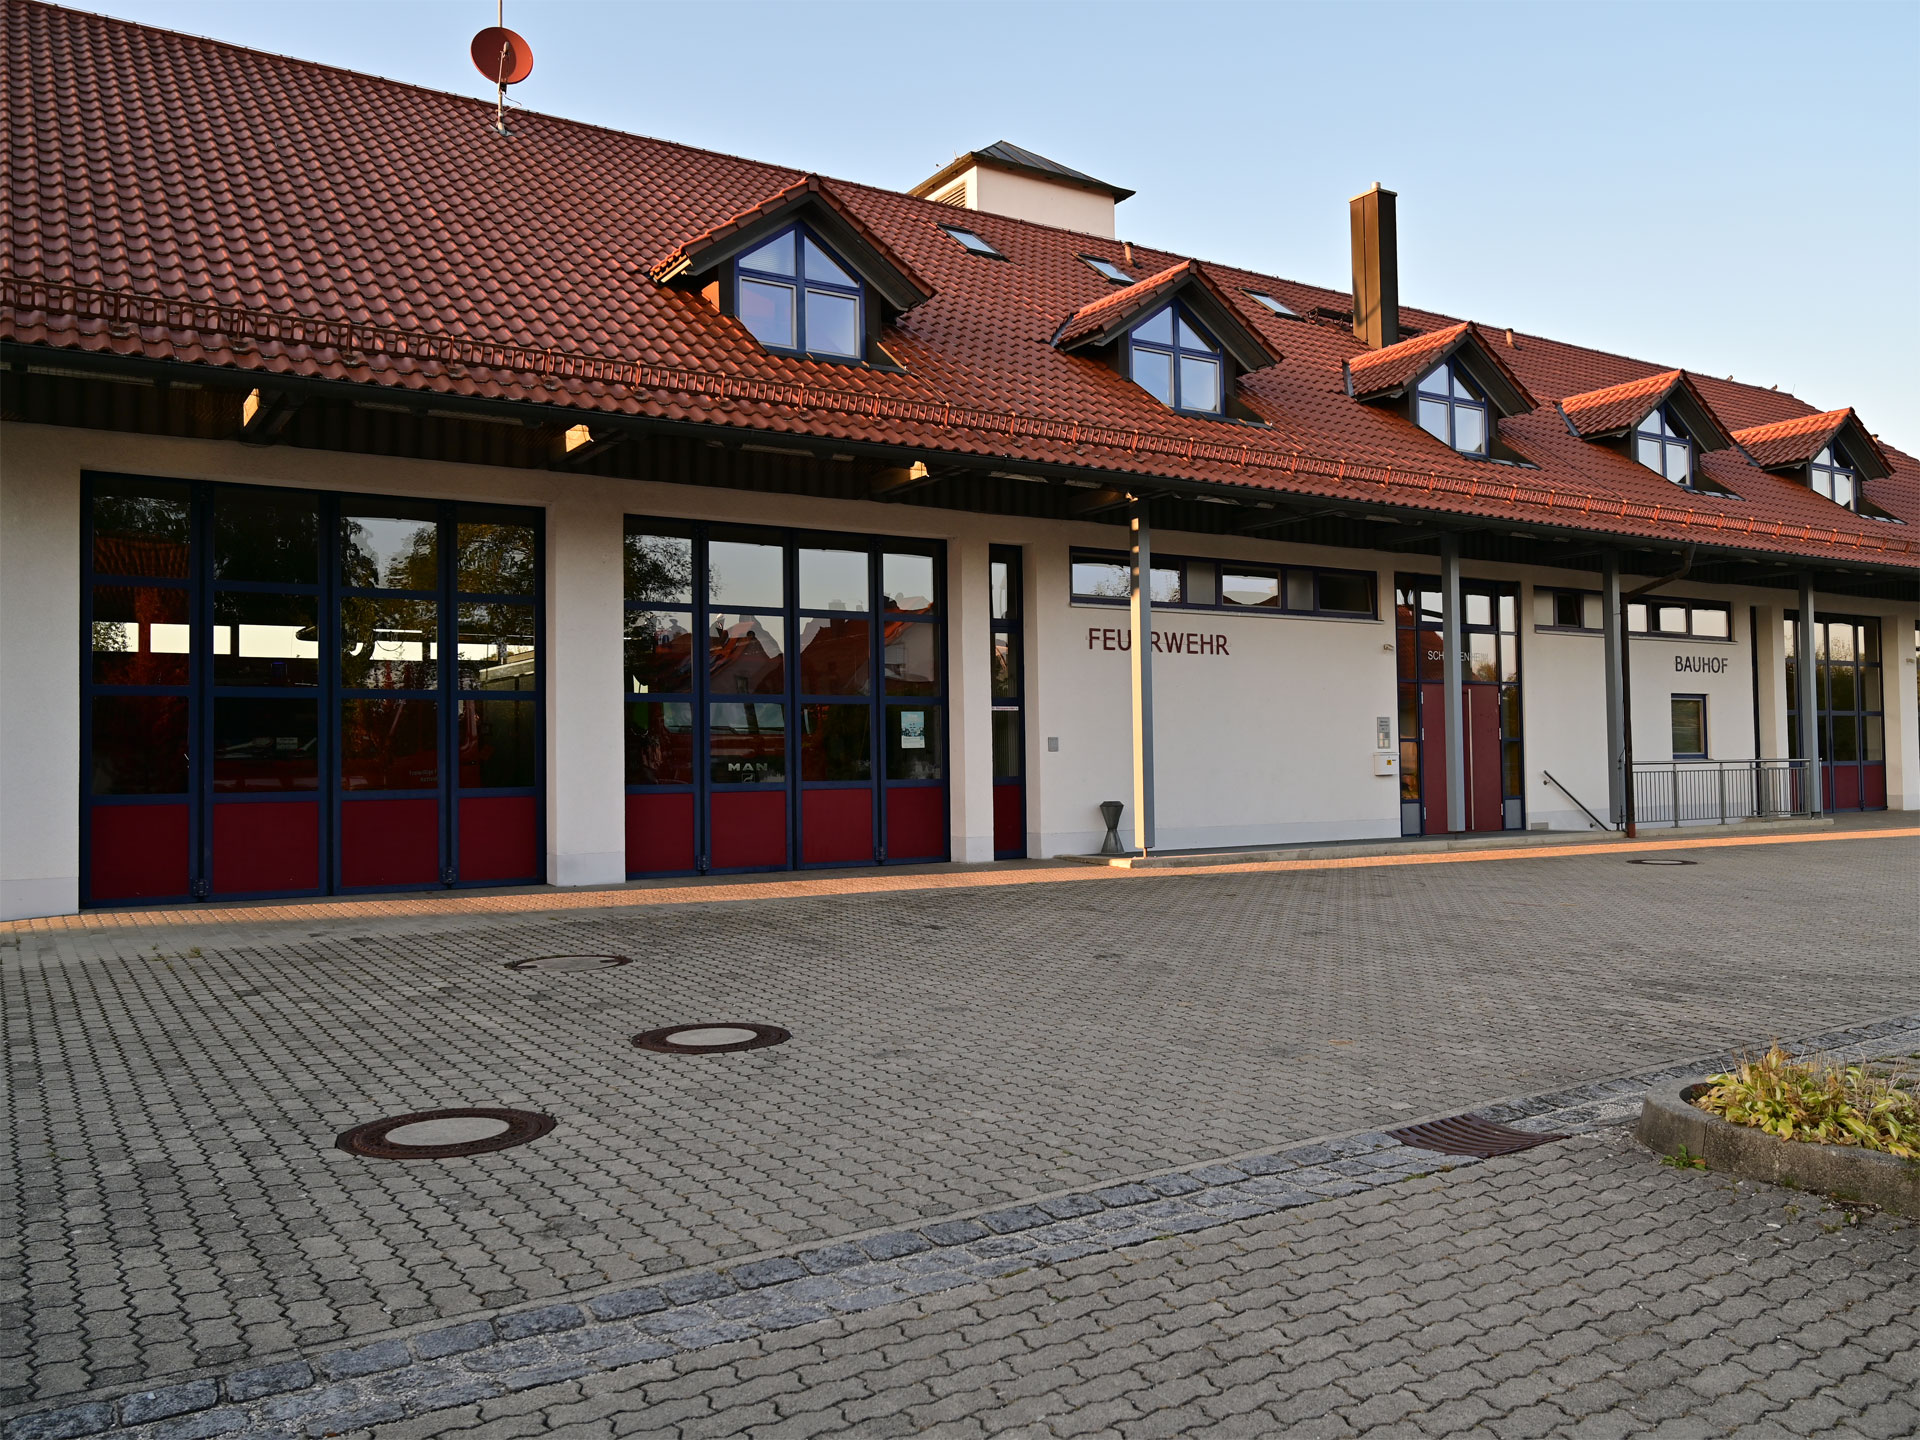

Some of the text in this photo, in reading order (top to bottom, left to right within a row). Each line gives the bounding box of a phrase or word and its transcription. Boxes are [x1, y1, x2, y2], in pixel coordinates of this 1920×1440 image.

[1088, 628, 1229, 655] FEURWEHR
[1675, 655, 1728, 673] BAUHOF
[727, 762, 768, 773] MAN
